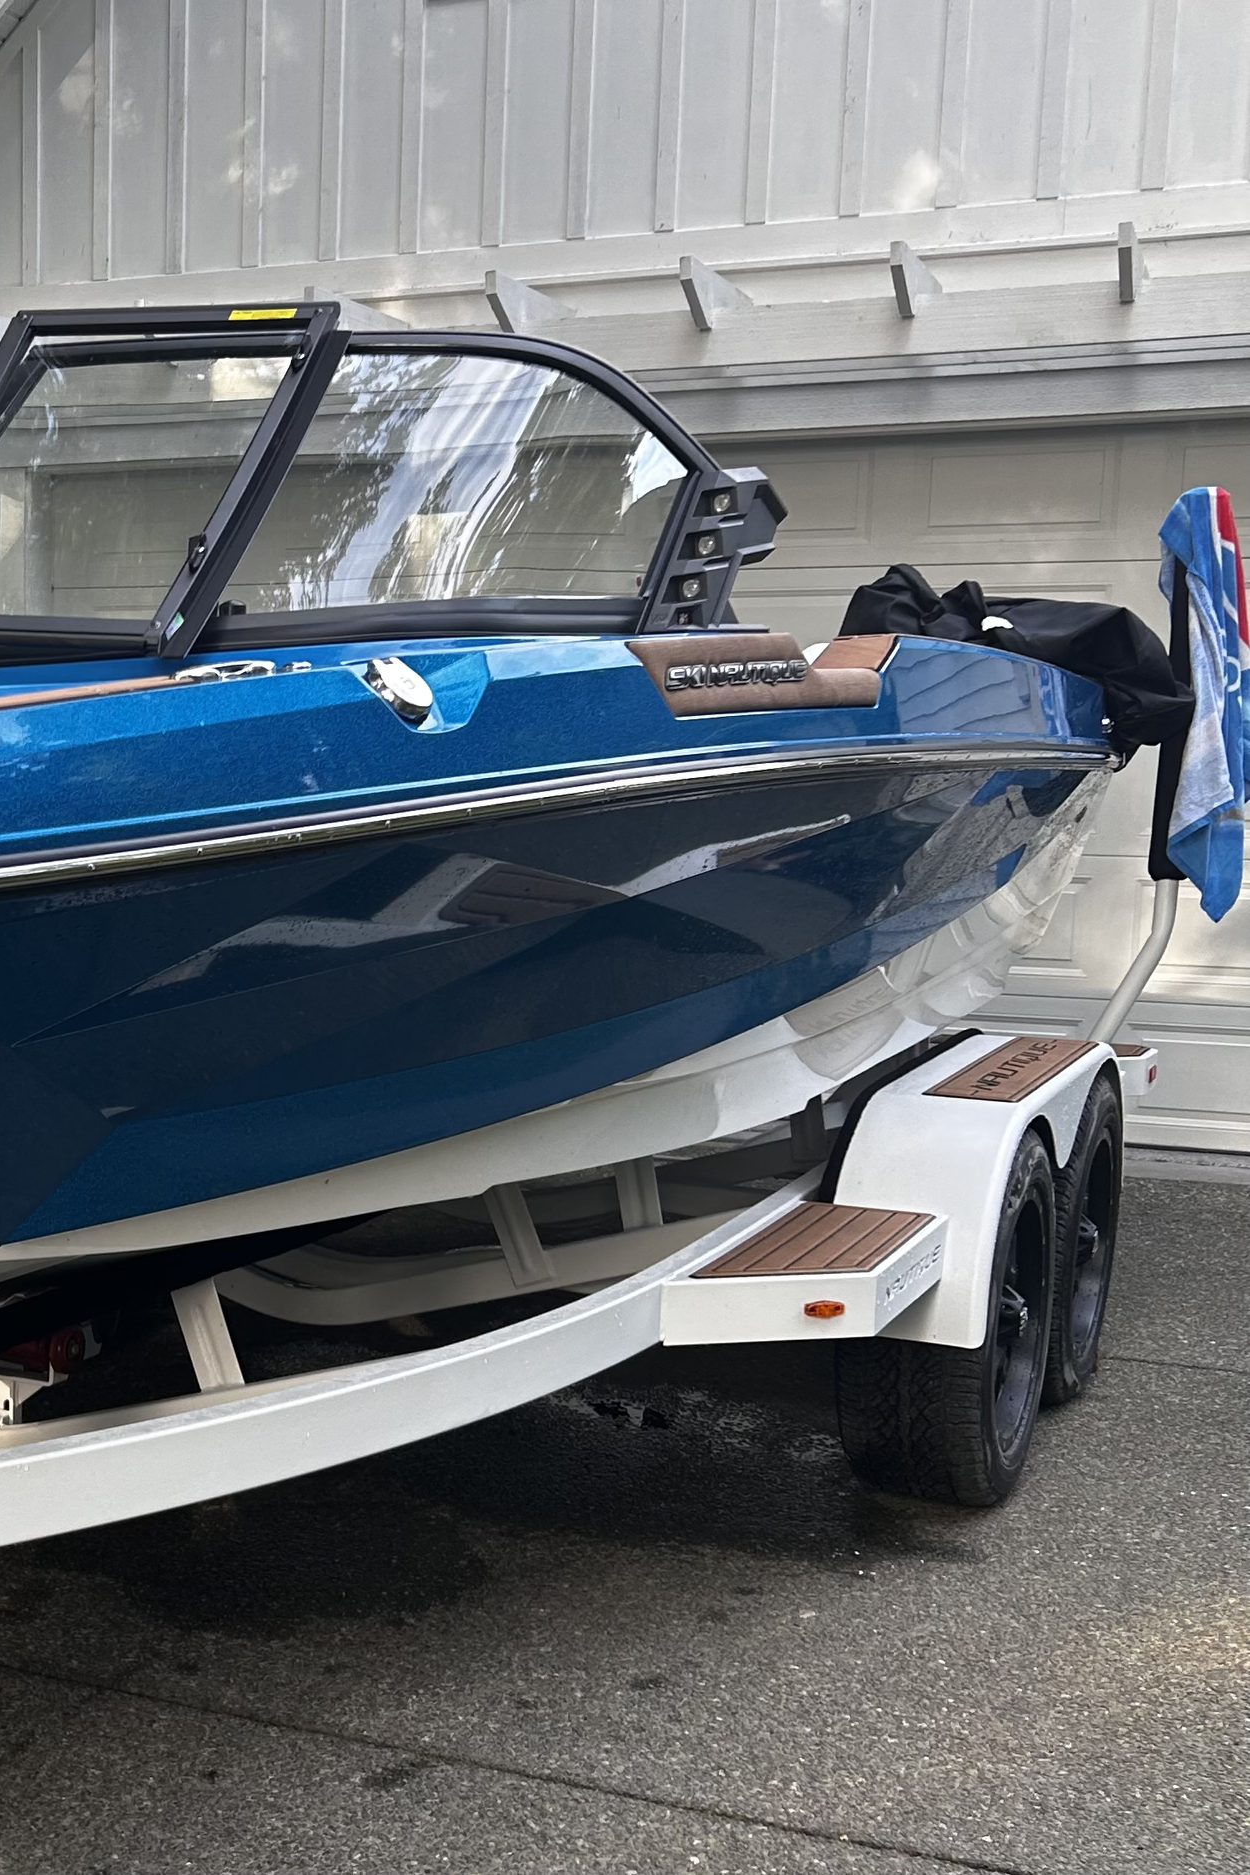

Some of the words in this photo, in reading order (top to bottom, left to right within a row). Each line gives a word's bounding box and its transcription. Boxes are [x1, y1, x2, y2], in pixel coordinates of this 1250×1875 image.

[665, 664, 706, 691] SKI
[707, 659, 808, 687] NAUTIQUE
[970, 1041, 1057, 1092] NAUTIQUE
